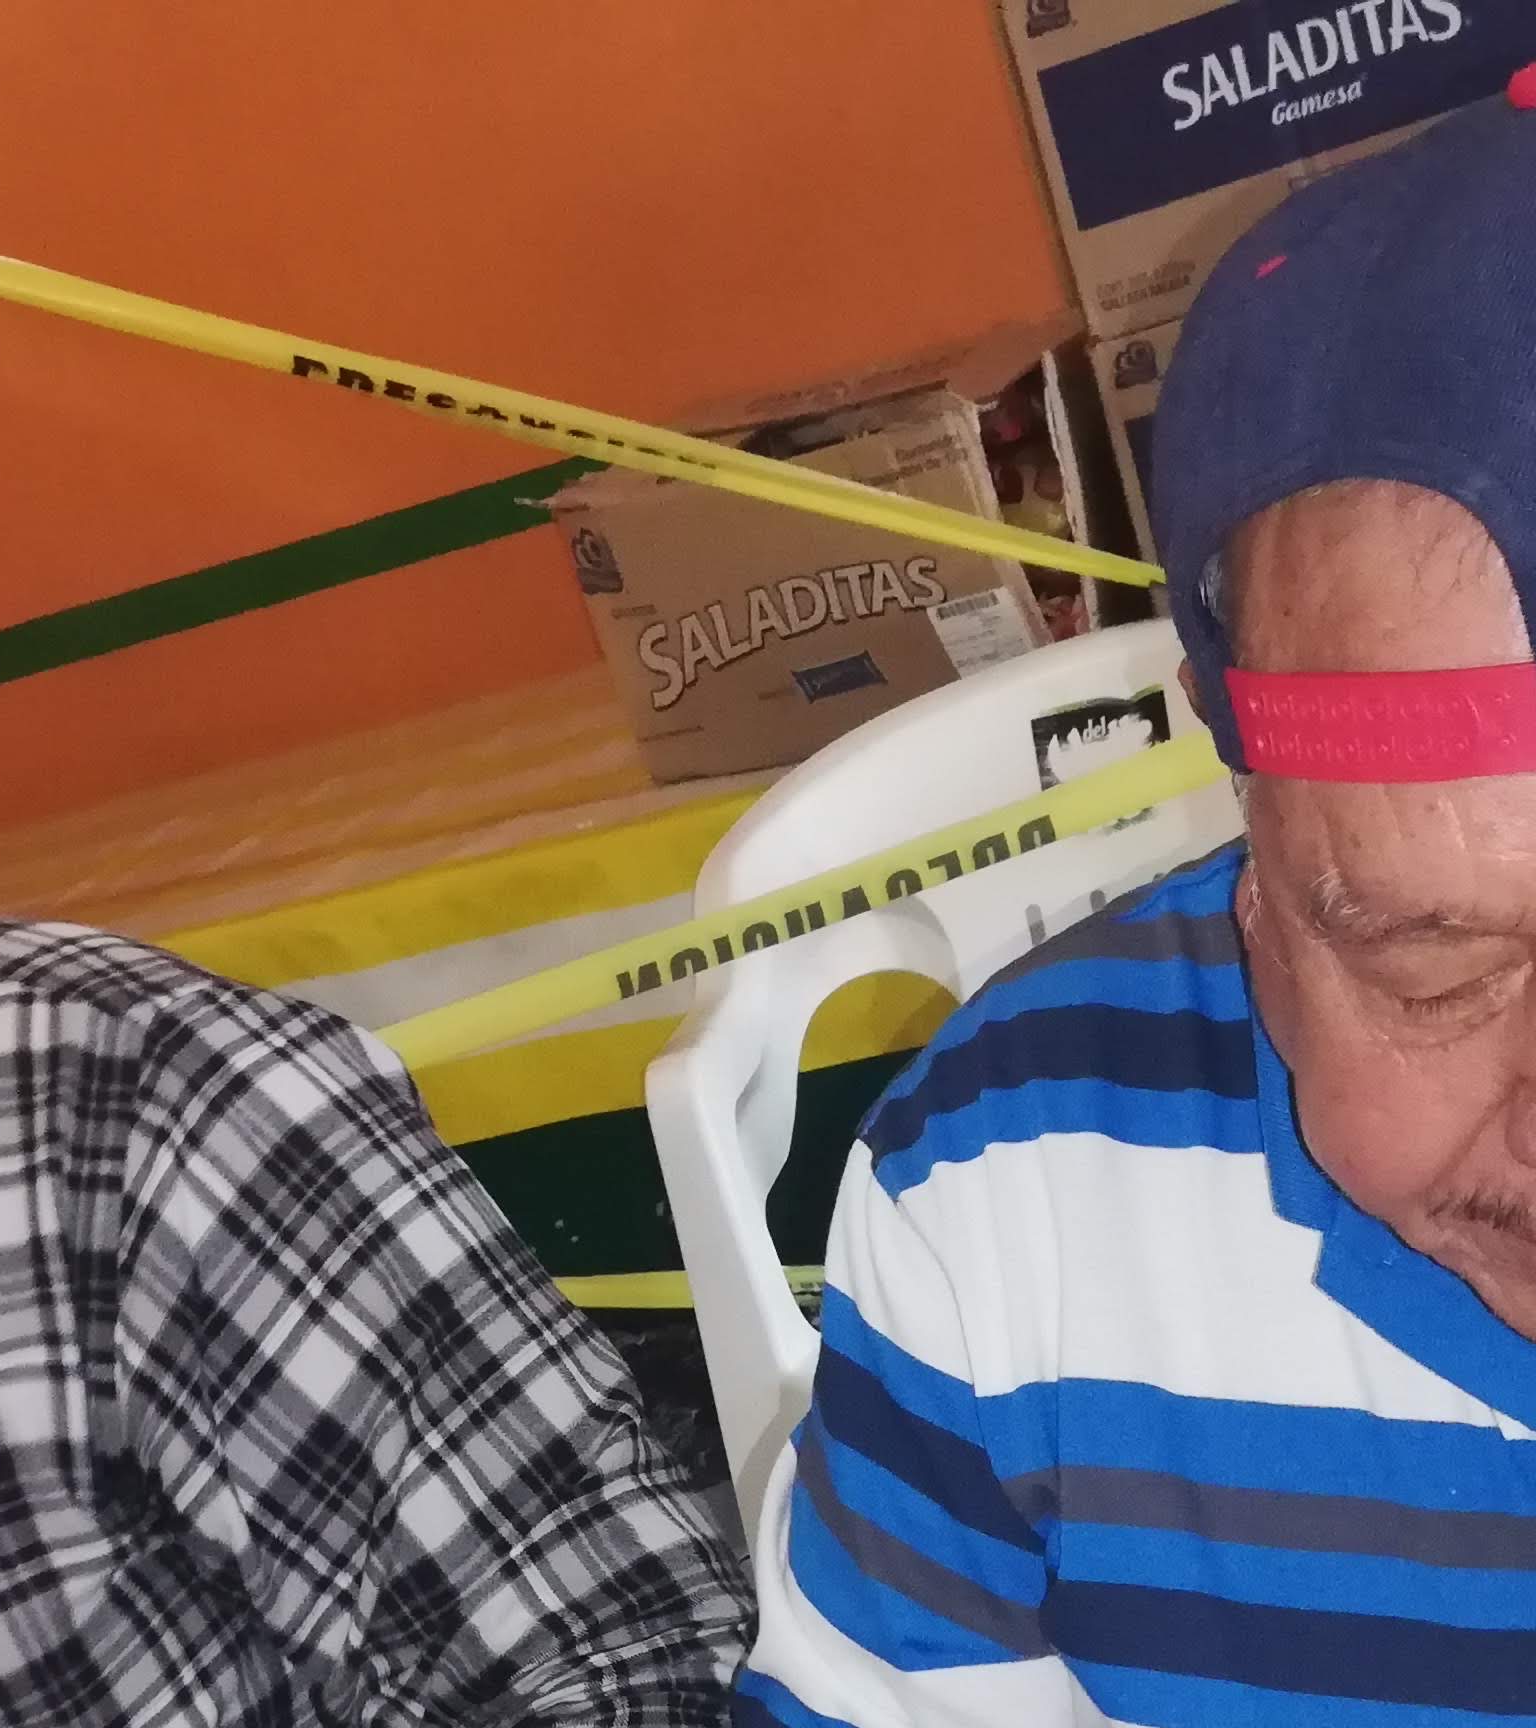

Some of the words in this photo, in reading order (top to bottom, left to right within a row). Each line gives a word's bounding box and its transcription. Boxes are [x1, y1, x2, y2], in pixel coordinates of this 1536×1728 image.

[1163, 0, 1463, 131] SALADITAS
[1270, 79, 1363, 126] Gamesa
[638, 557, 947, 711] SALADITAS
